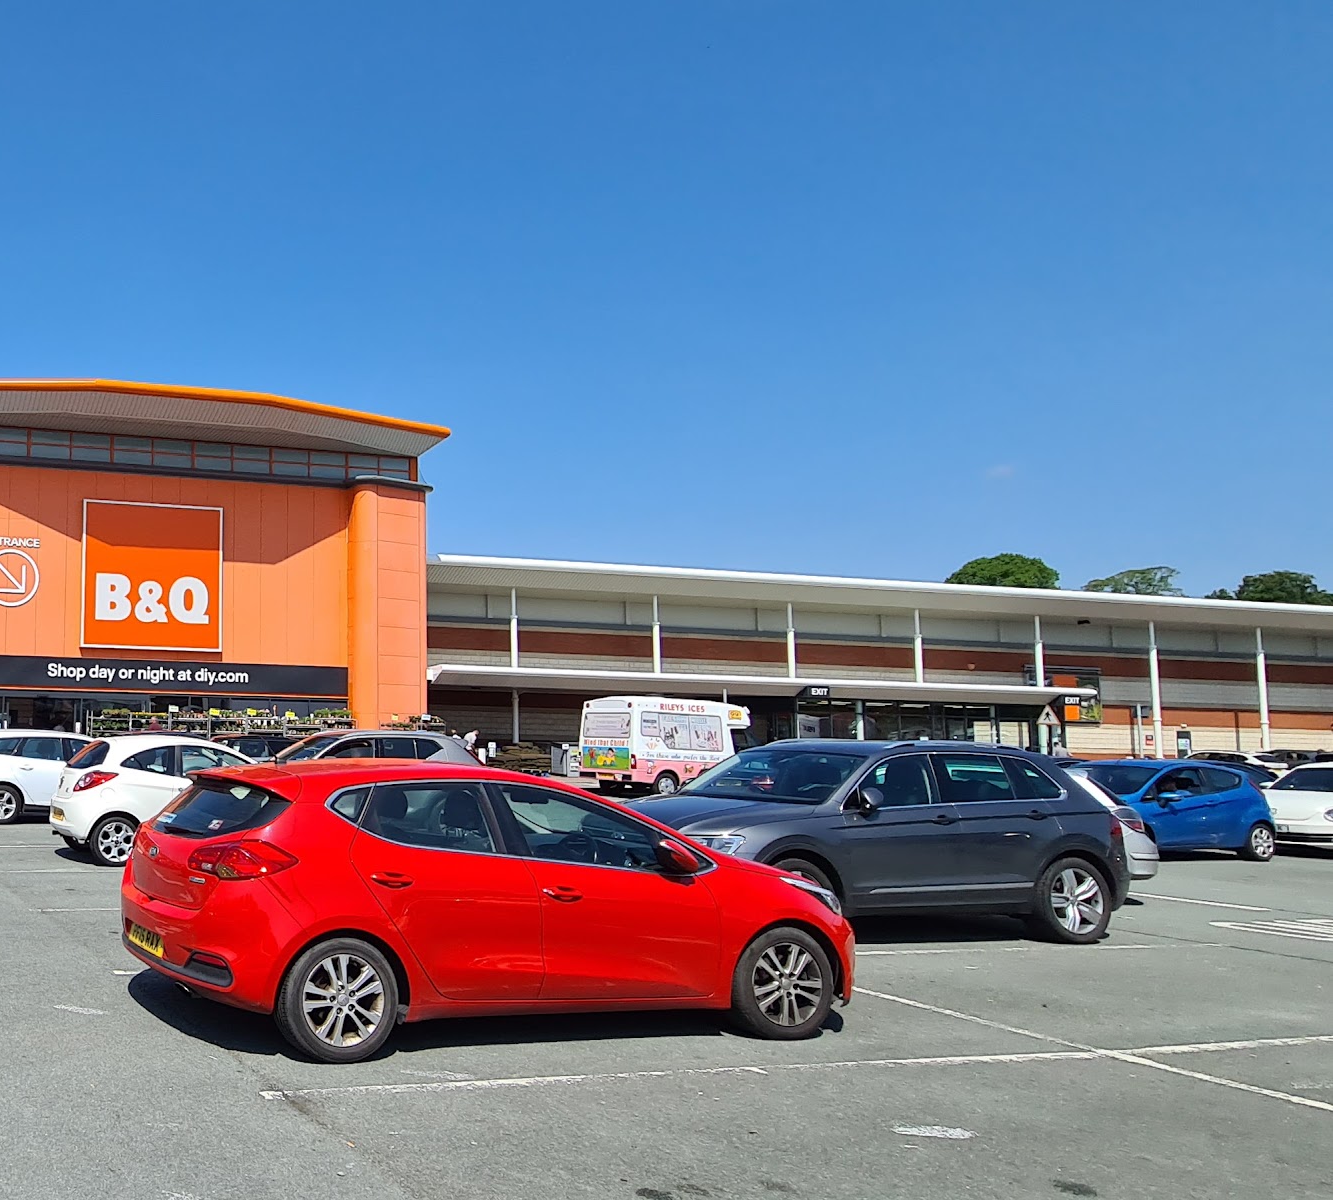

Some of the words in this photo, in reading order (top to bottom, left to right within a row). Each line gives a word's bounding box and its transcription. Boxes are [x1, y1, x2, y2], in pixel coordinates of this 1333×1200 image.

[95, 572, 209, 624] B&Q
[47, 662, 86, 682] Shop
[88, 664, 116, 682] day
[118, 669, 136, 680] or
[137, 665, 175, 685] night
[177, 670, 192, 682] at
[194, 668, 249, 686] diy.com
[811, 688, 829, 696] EXIT
[1064, 696, 1080, 705] EXIT
[660, 703, 685, 712] RILEYS
[688, 704, 706, 713] ICES
